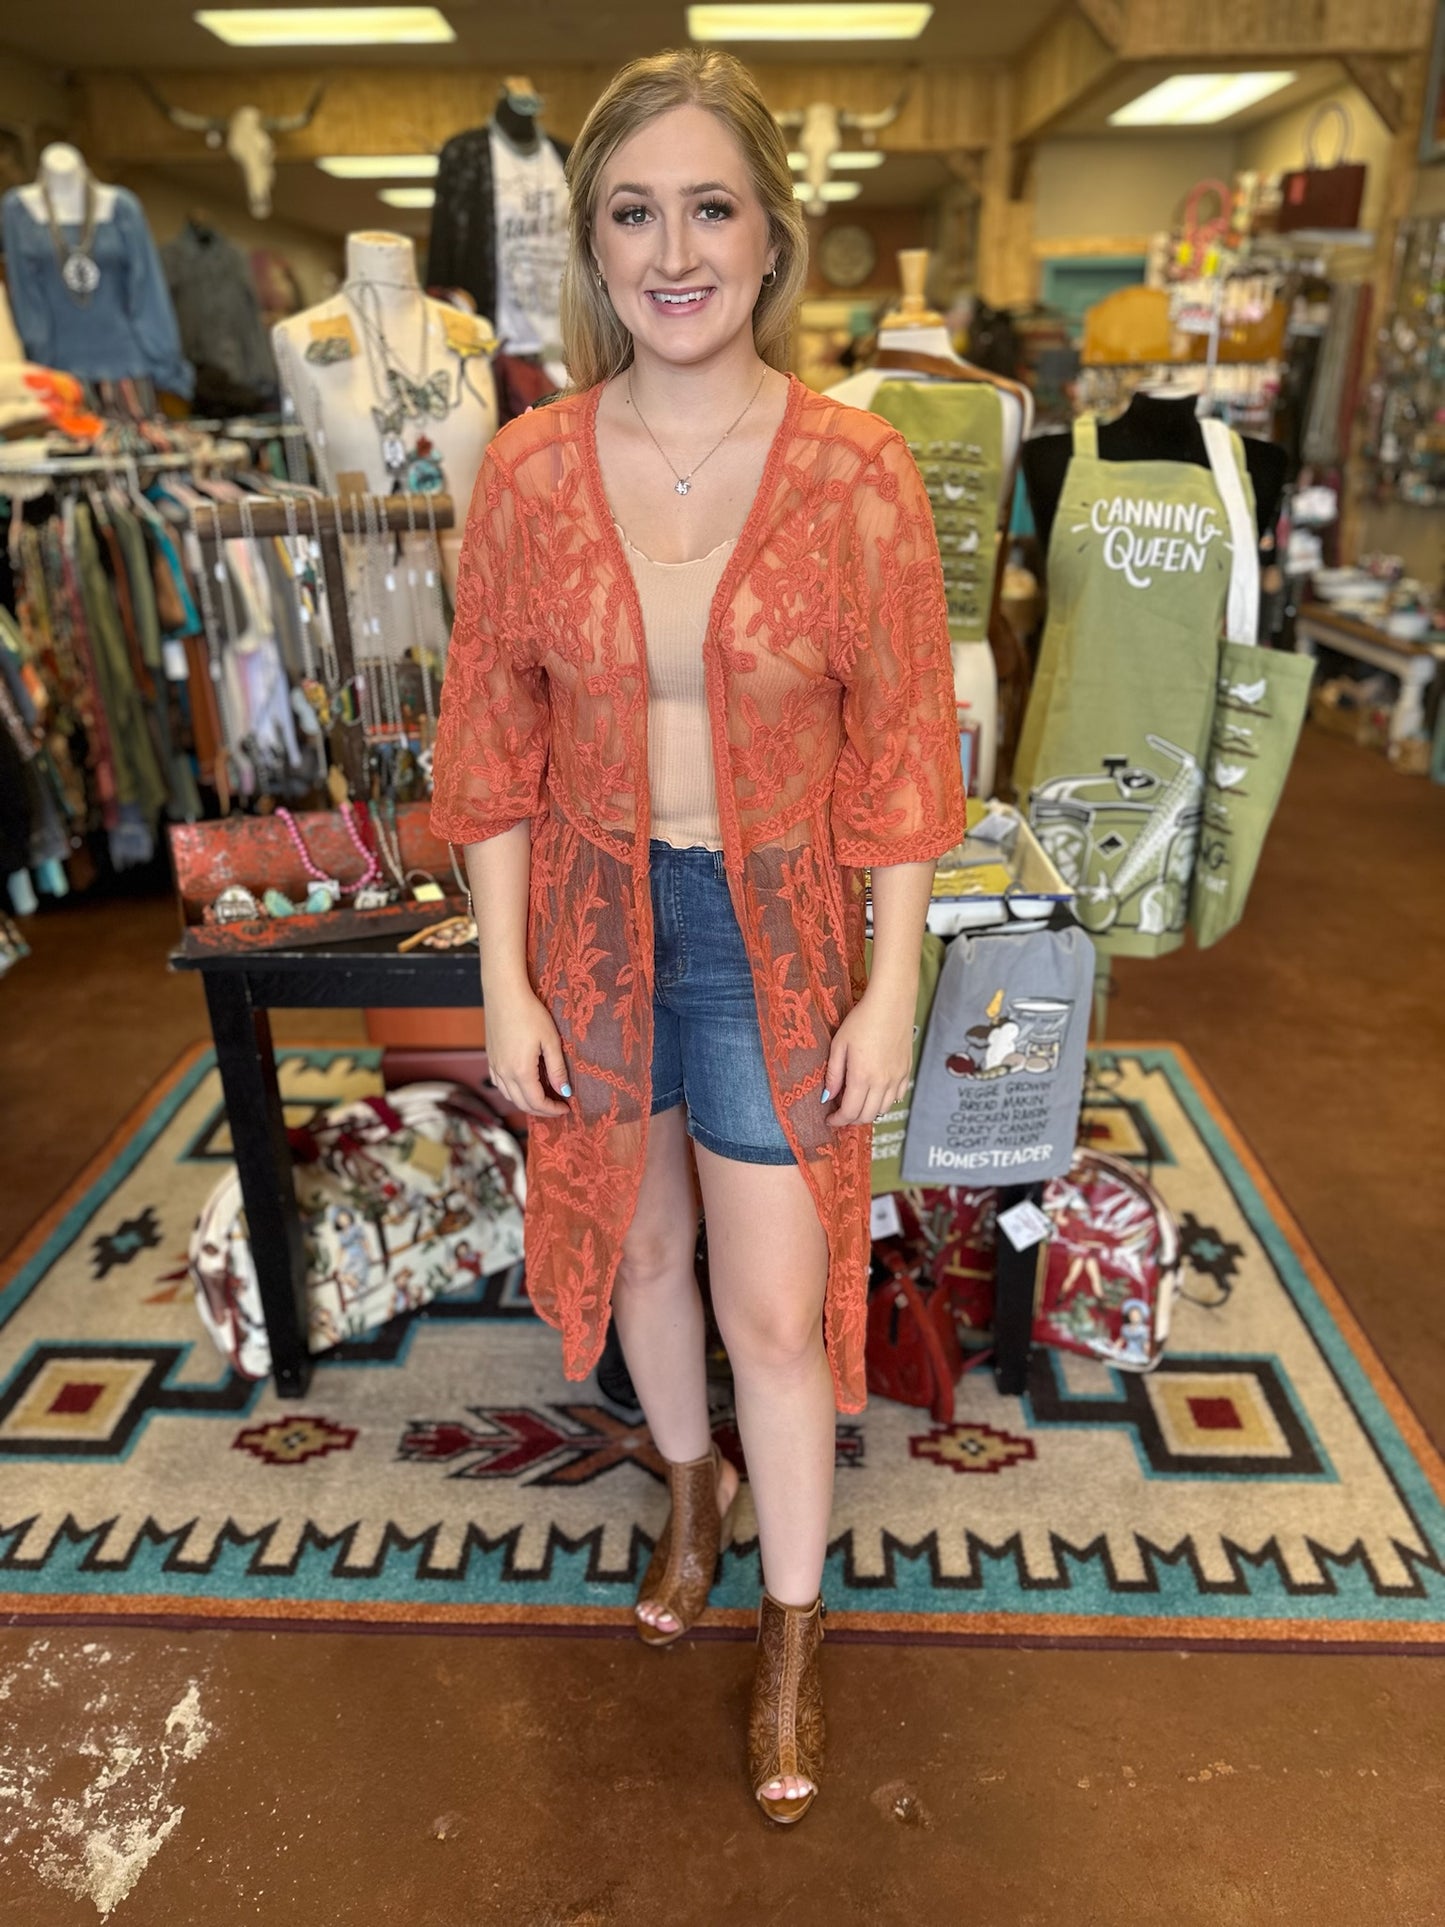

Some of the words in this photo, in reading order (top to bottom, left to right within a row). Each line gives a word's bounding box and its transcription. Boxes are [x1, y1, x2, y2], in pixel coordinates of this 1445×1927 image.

[1091, 496, 1223, 544] CANNING
[1103, 525, 1207, 588] QUEEN
[959, 1100, 998, 1112] BREAD
[950, 1111, 1009, 1123] CHICKEN
[946, 1124, 995, 1136] CRAZY
[946, 1136, 990, 1148] GOAT
[928, 1144, 1053, 1169] HOMESTEADER
